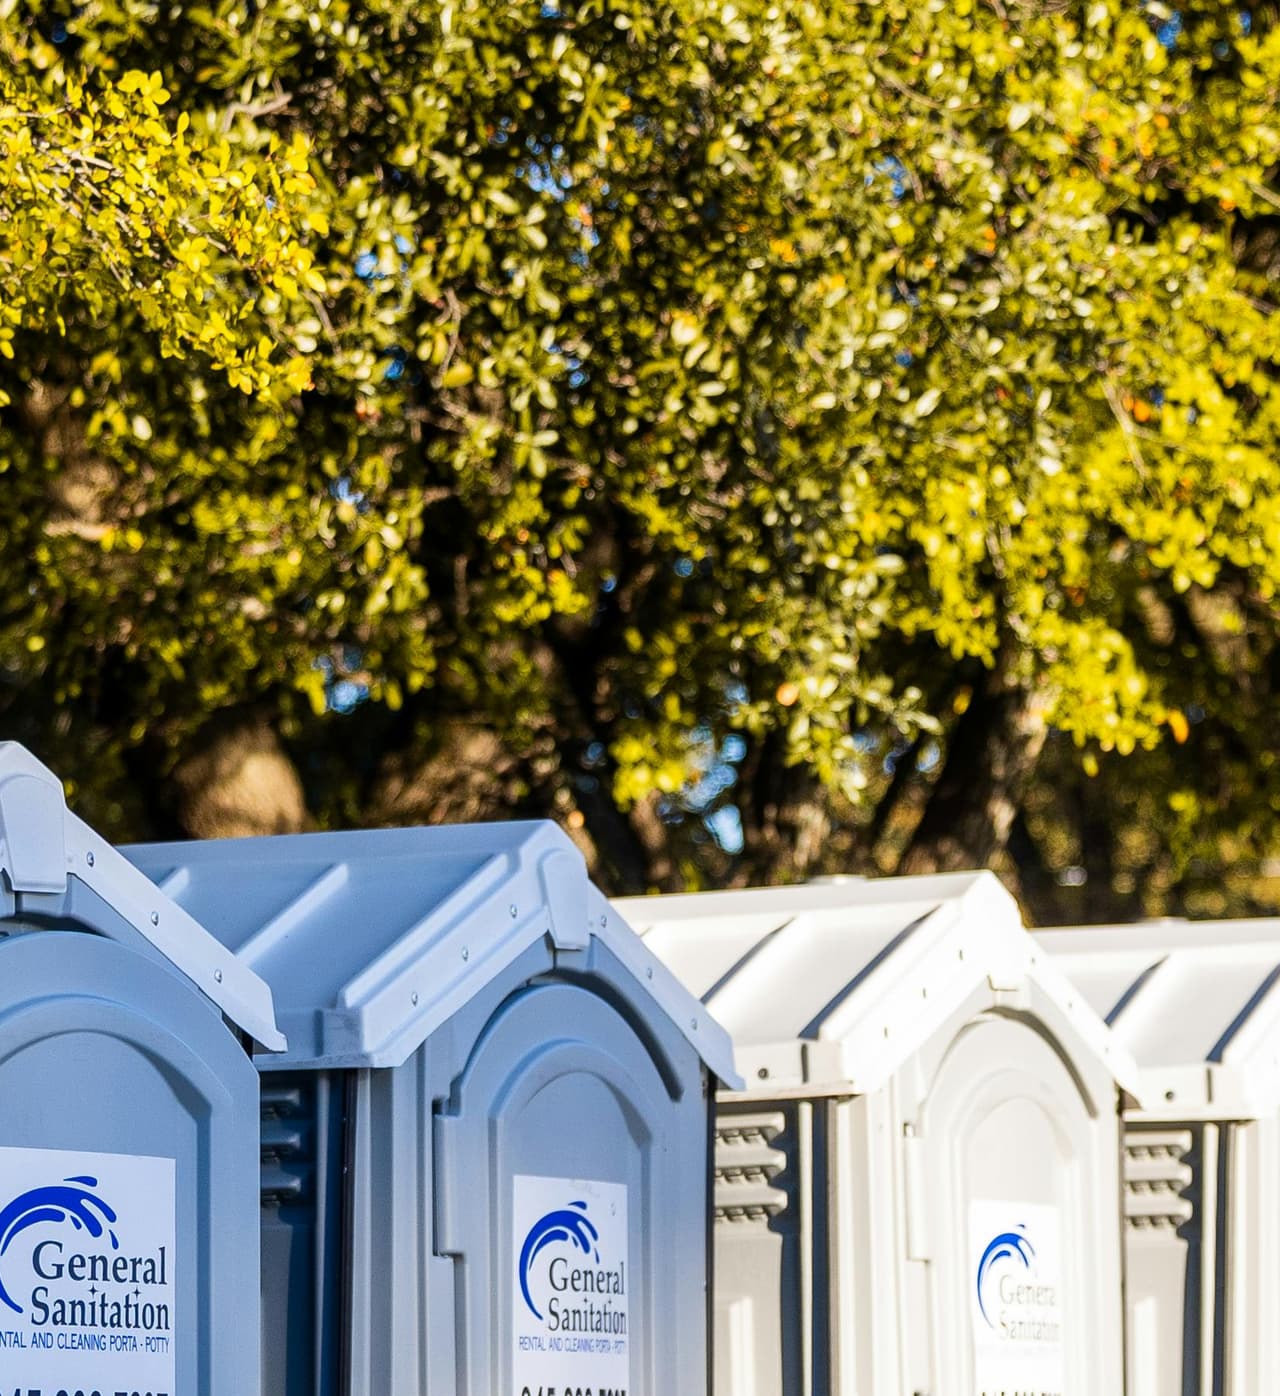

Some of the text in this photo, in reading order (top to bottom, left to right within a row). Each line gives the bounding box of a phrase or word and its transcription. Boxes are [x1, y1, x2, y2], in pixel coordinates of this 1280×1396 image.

[32, 1240, 168, 1285] General
[549, 1257, 625, 1295] General
[31, 1285, 170, 1331] Sanitation
[999, 1273, 1057, 1306] Genera
[548, 1297, 627, 1335] Sanitation
[31, 1332, 54, 1349] AND
[57, 1333, 107, 1351] CLEANING
[109, 1335, 138, 1352] PORTA
[145, 1336, 170, 1354] POTTY
[519, 1336, 546, 1351] RENTAL
[548, 1337, 562, 1352] AND
